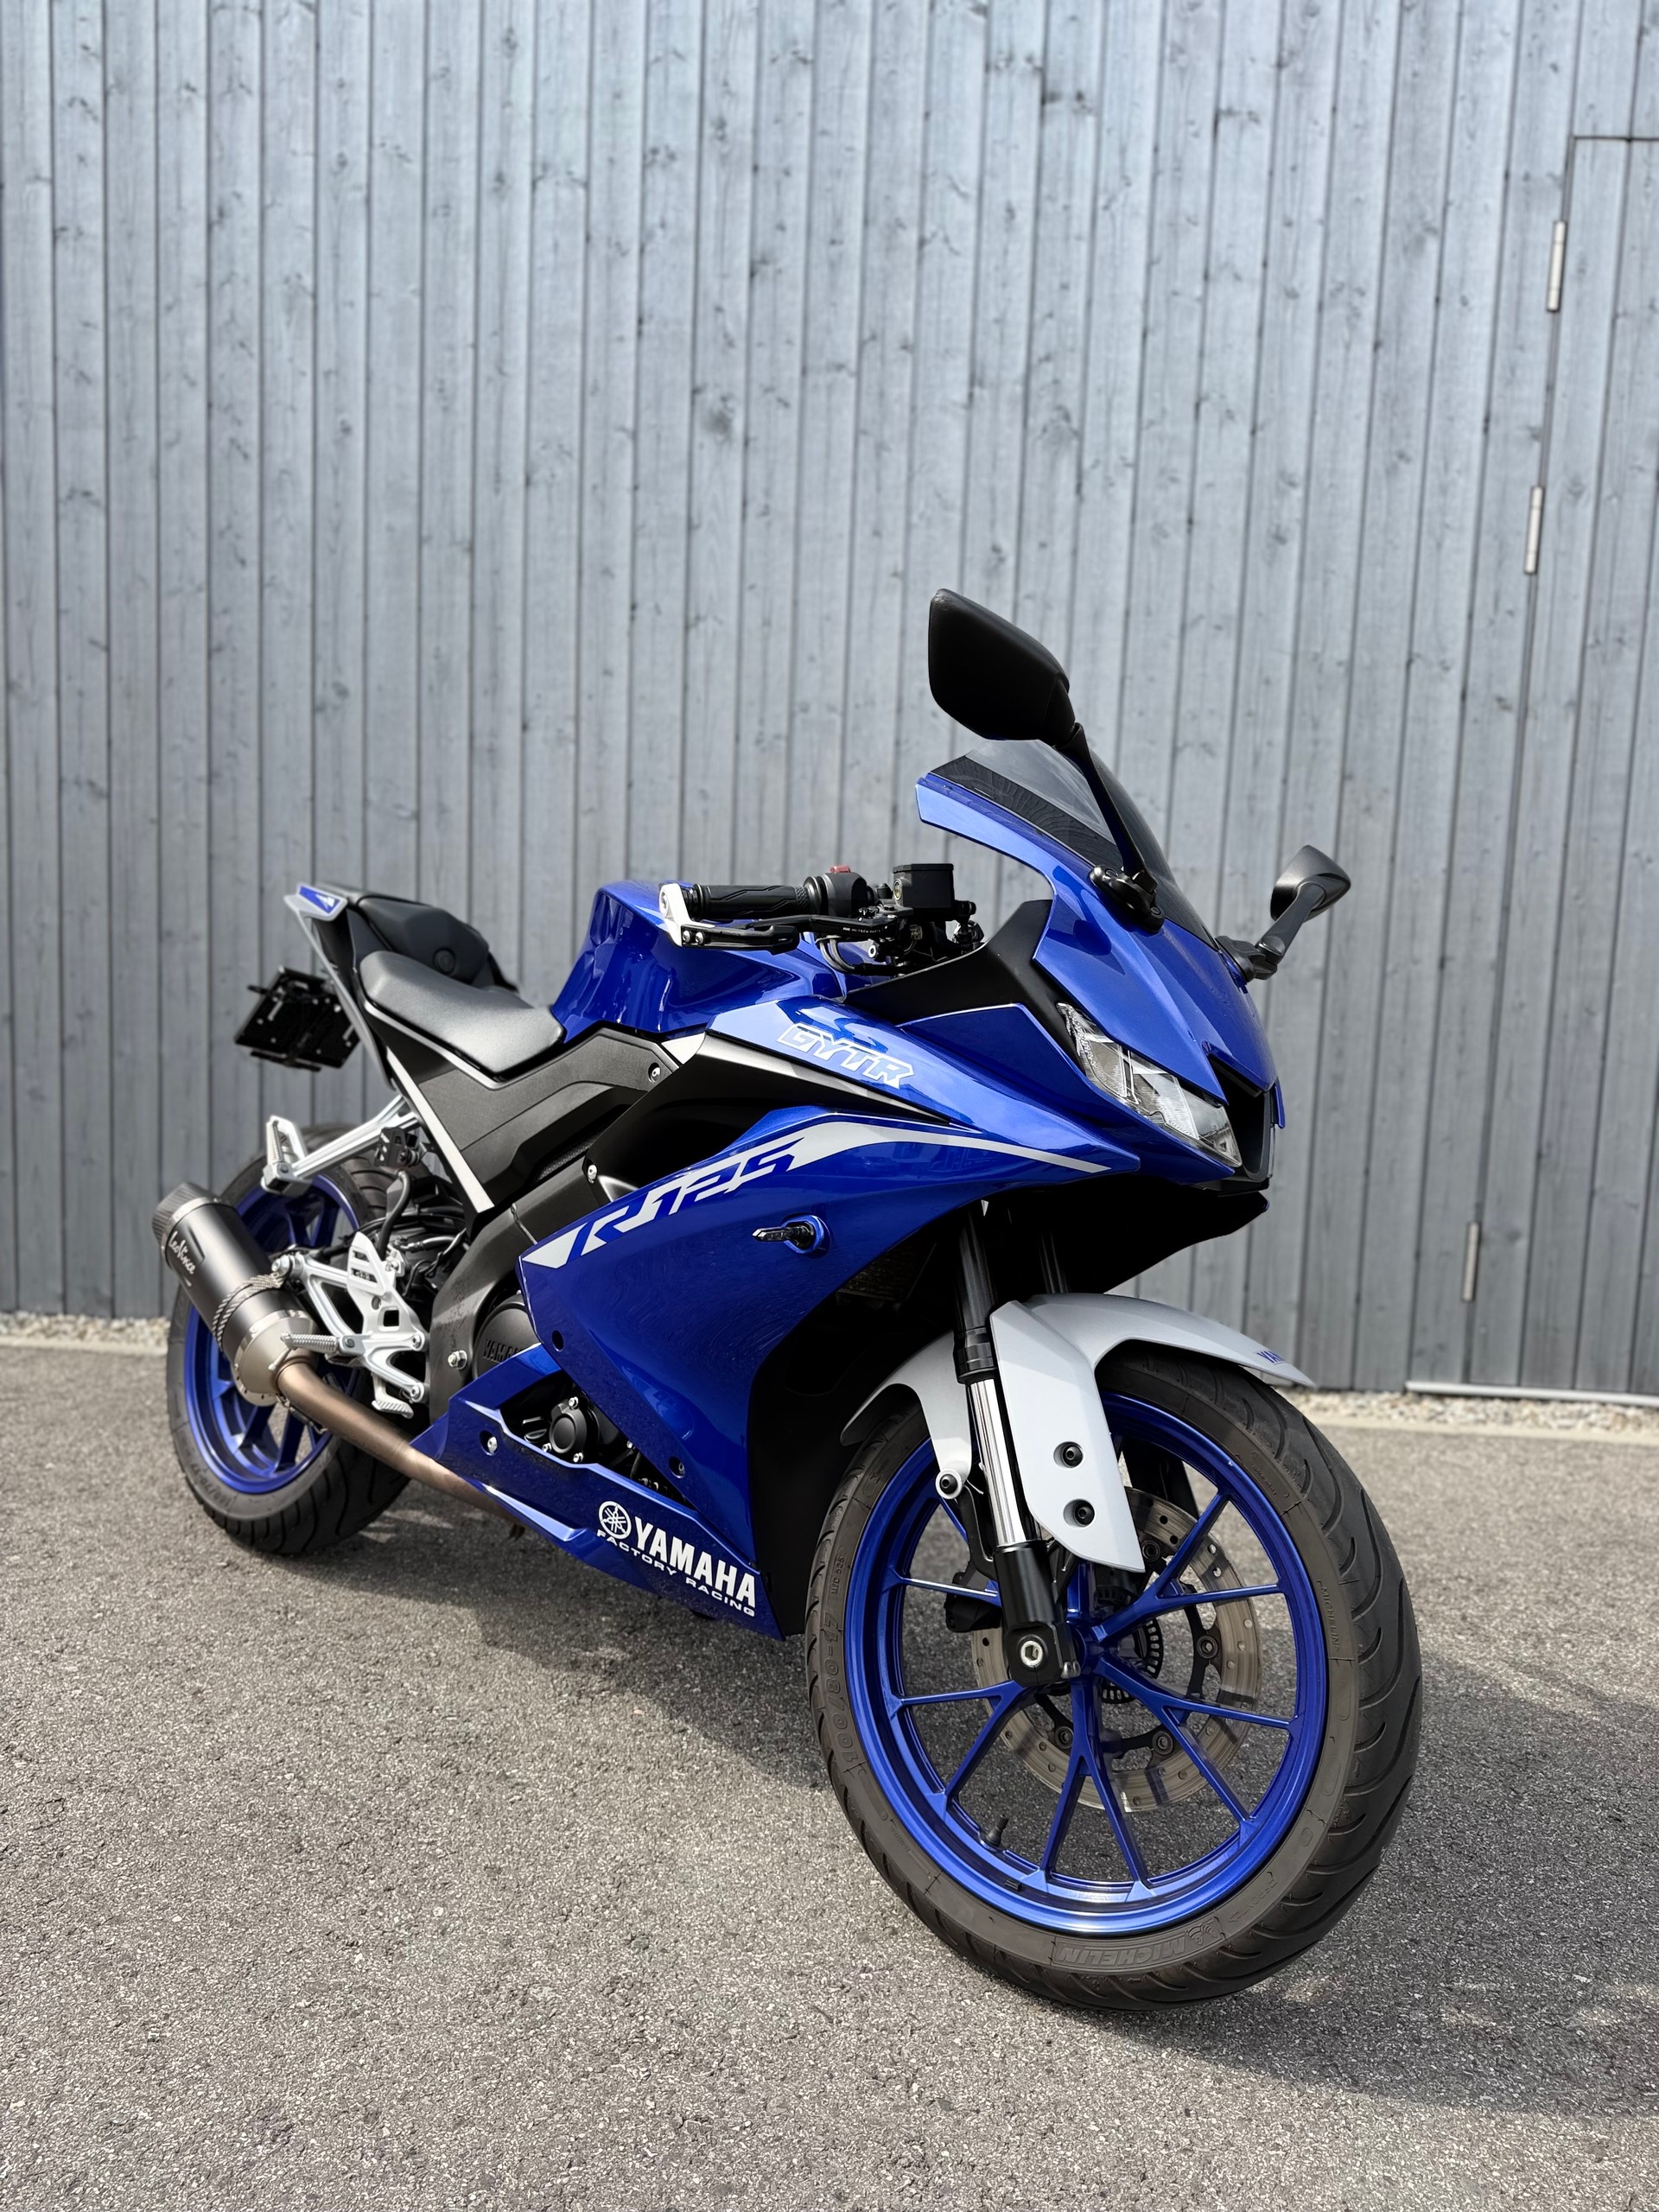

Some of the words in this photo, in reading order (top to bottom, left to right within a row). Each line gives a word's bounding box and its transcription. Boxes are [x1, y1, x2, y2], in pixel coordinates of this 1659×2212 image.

[777, 1022, 915, 1090] GYTR
[596, 1529, 678, 1576] FACTORY
[685, 1577, 756, 1618] RACING
[634, 1516, 756, 1608] YAMAHA
[823, 1611, 859, 1763] 100/80-17
[1058, 1936, 1186, 1966] MICHELIN
